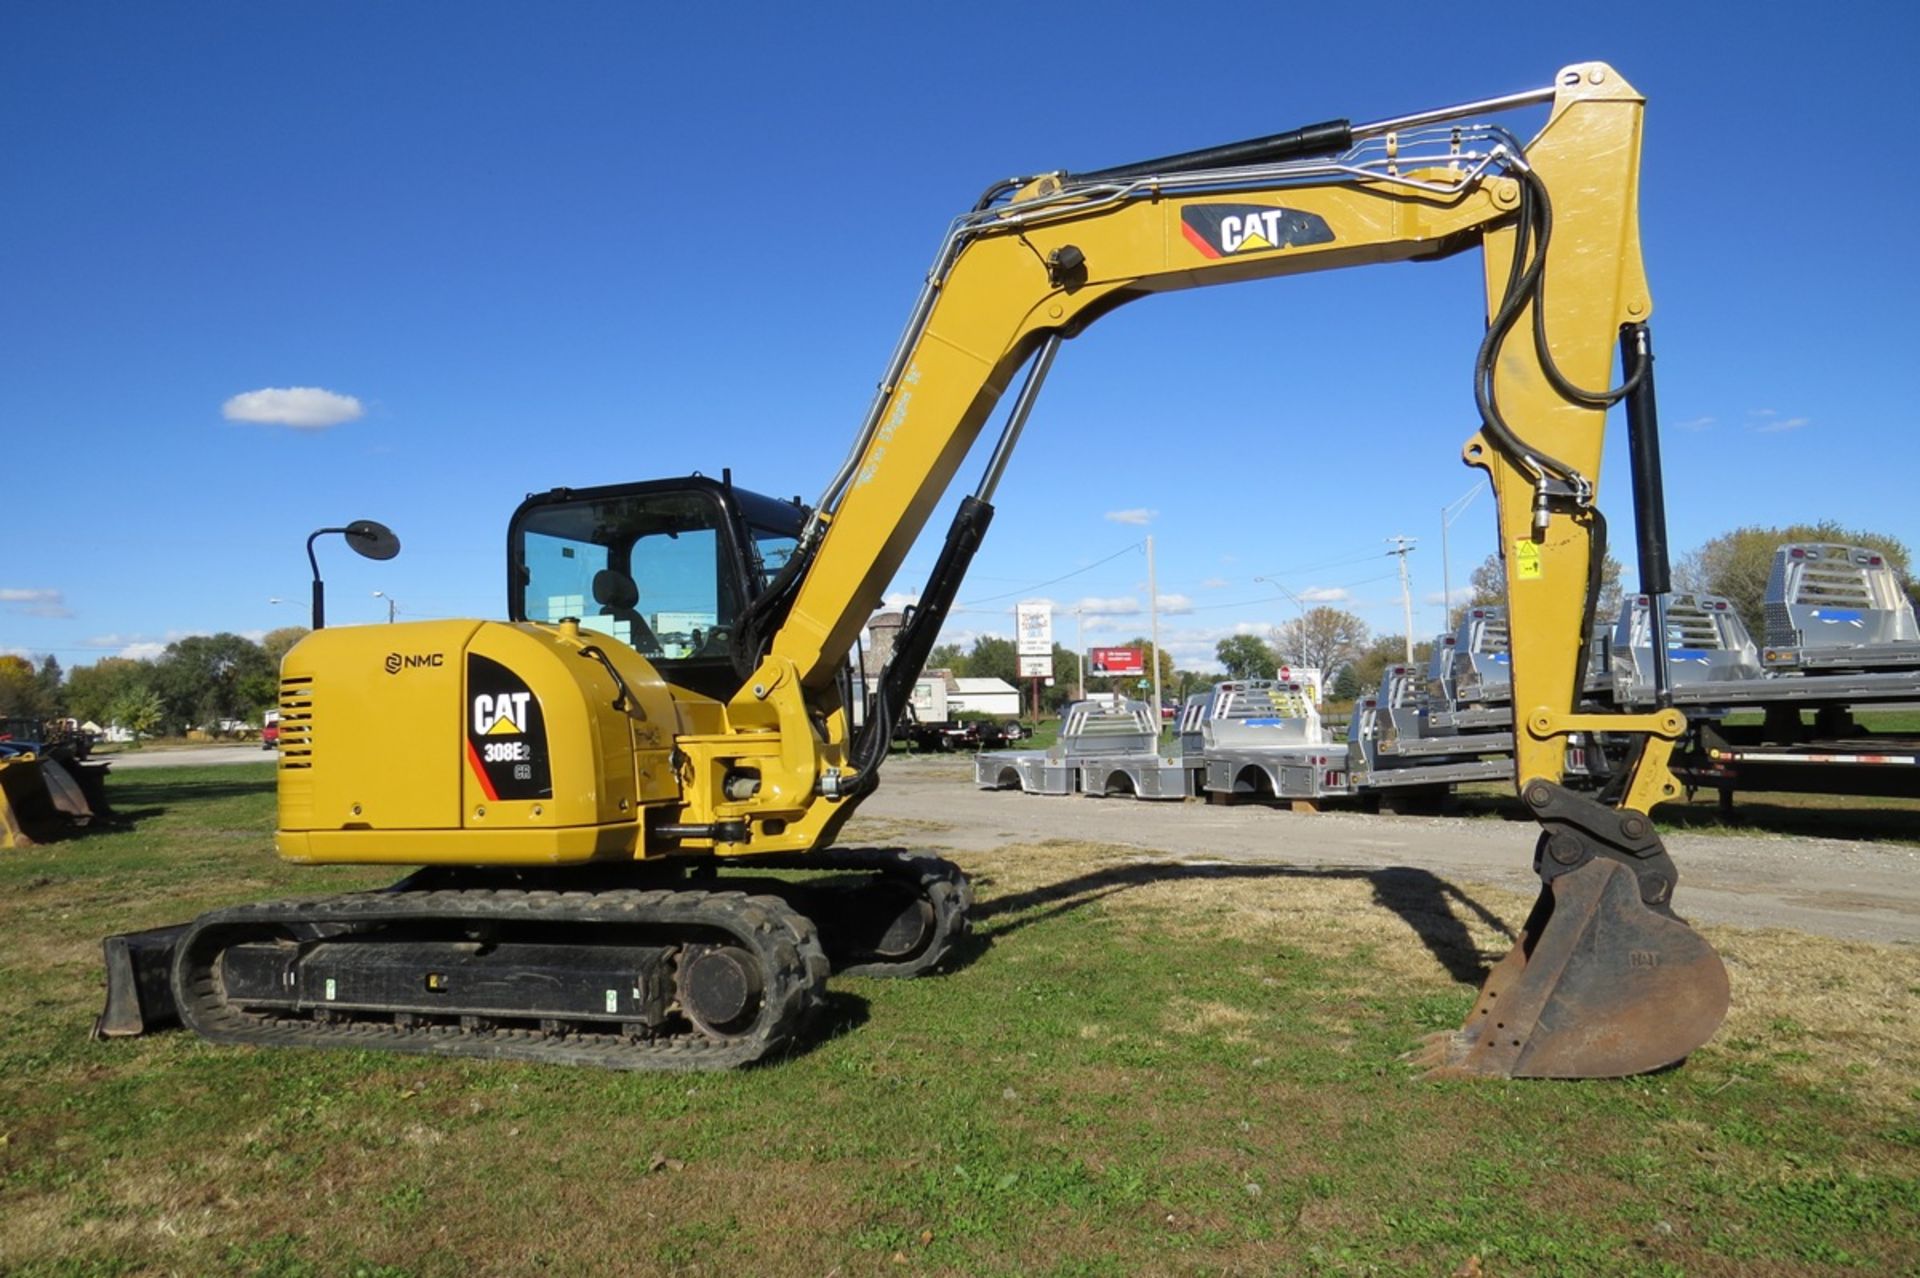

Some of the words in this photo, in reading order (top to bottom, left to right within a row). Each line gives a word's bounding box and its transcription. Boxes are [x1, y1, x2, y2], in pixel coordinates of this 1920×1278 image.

[1221, 209, 1282, 253] CAT
[404, 653, 444, 668] NMC
[475, 692, 530, 735] CAT
